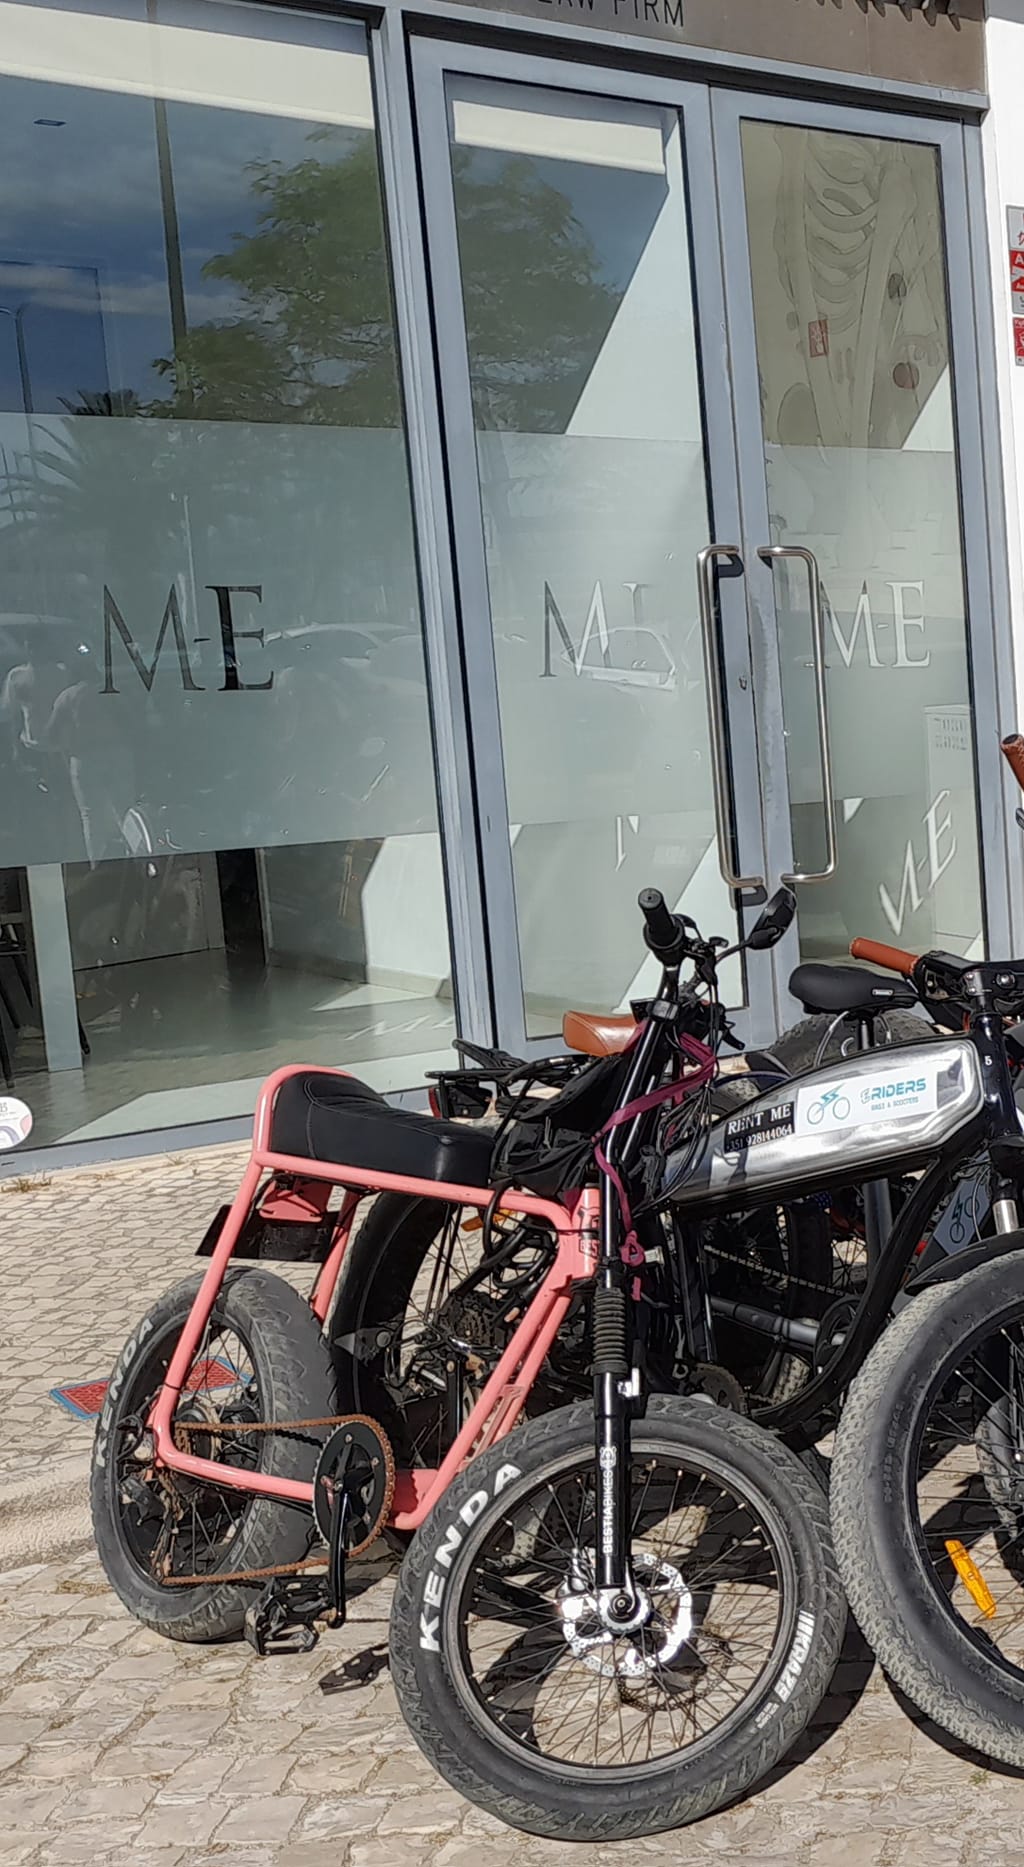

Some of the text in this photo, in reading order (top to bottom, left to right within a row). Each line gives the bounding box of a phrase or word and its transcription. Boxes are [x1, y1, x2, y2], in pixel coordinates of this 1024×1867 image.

[984, 1055, 993, 1066] 5
[727, 1103, 792, 1135] RENT ME
[746, 1123, 793, 1146] 928144064
[95, 1318, 154, 1468] KENDA
[602, 1469, 614, 1554] BESTIABIKES
[420, 1462, 522, 1653] KENDA
